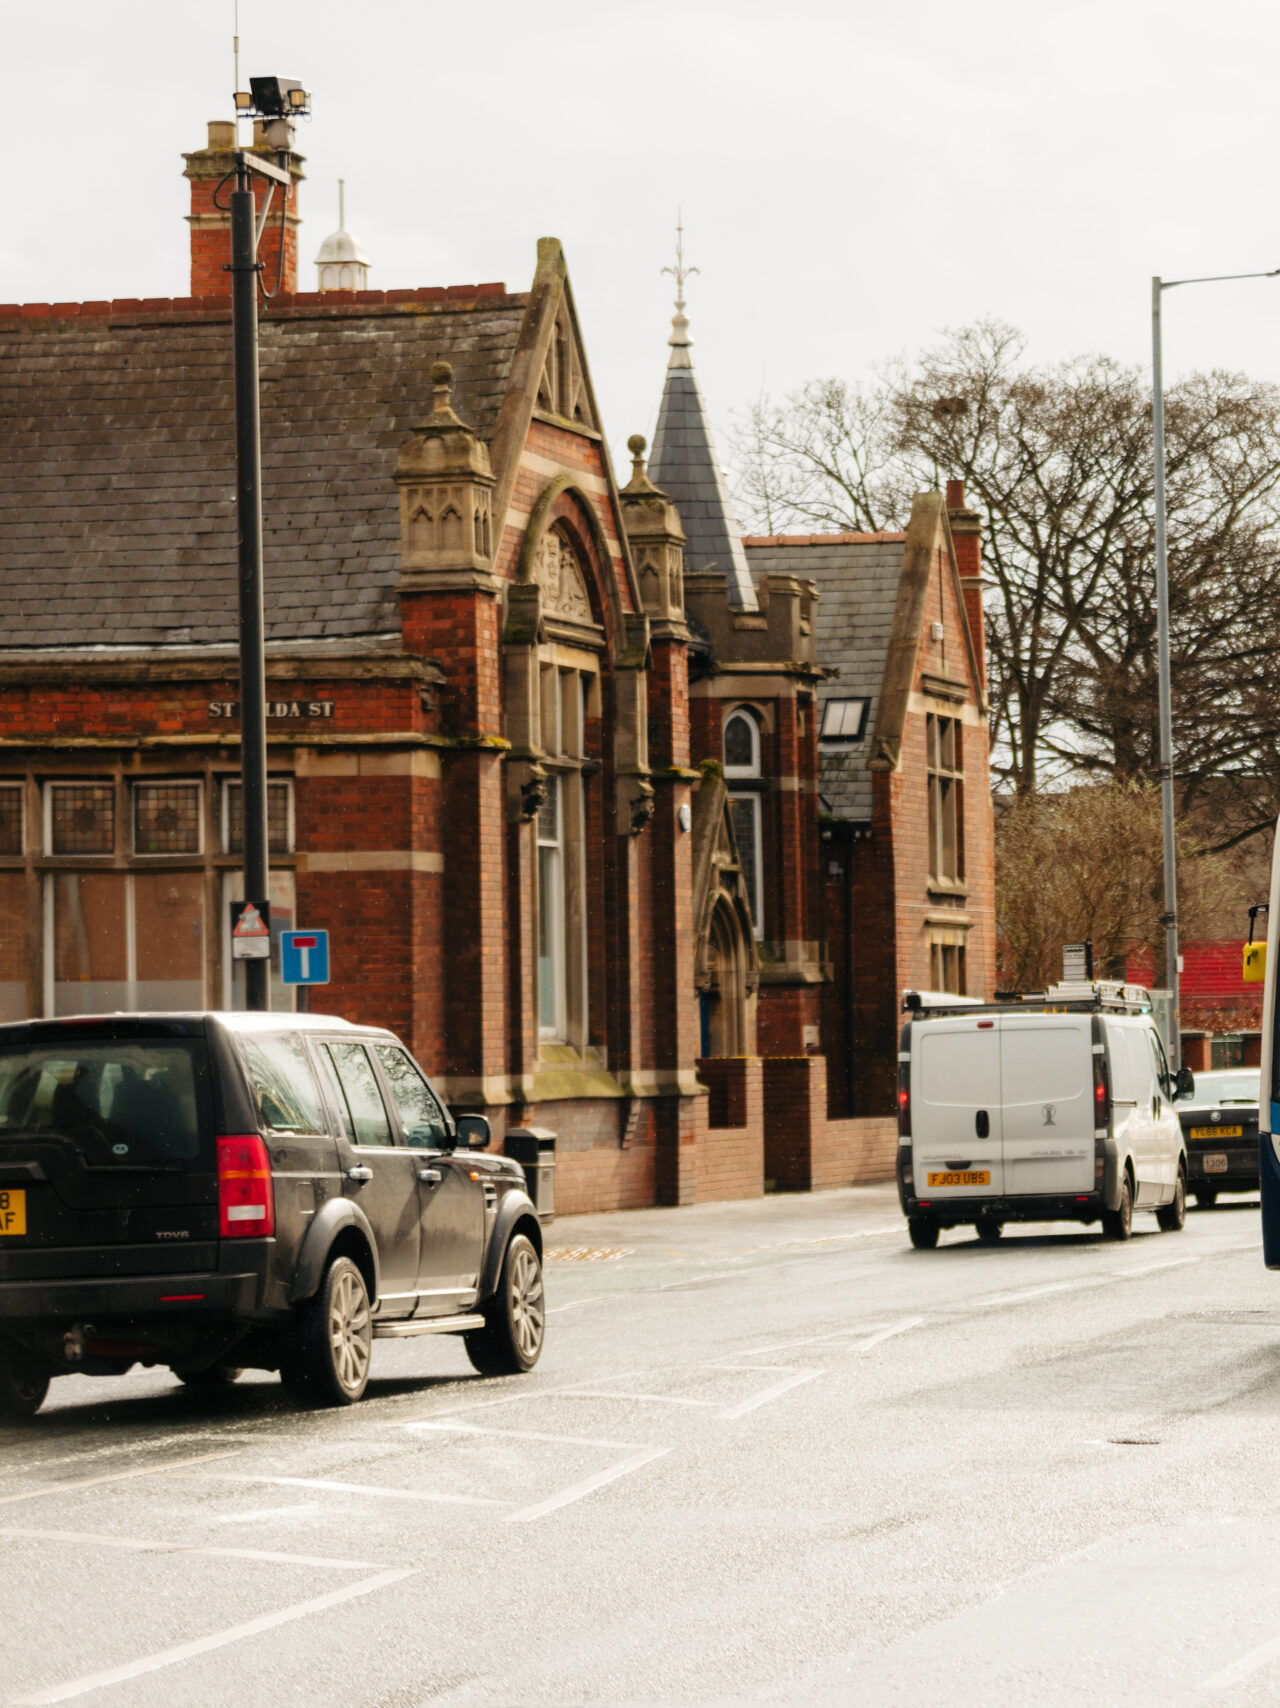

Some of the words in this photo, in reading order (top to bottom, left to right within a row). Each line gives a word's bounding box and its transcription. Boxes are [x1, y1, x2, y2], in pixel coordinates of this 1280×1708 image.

[208, 701, 235, 717] ST
[308, 701, 334, 717] ST
[931, 1174, 961, 1186] FJ03
[963, 1173, 985, 1184] UBS
